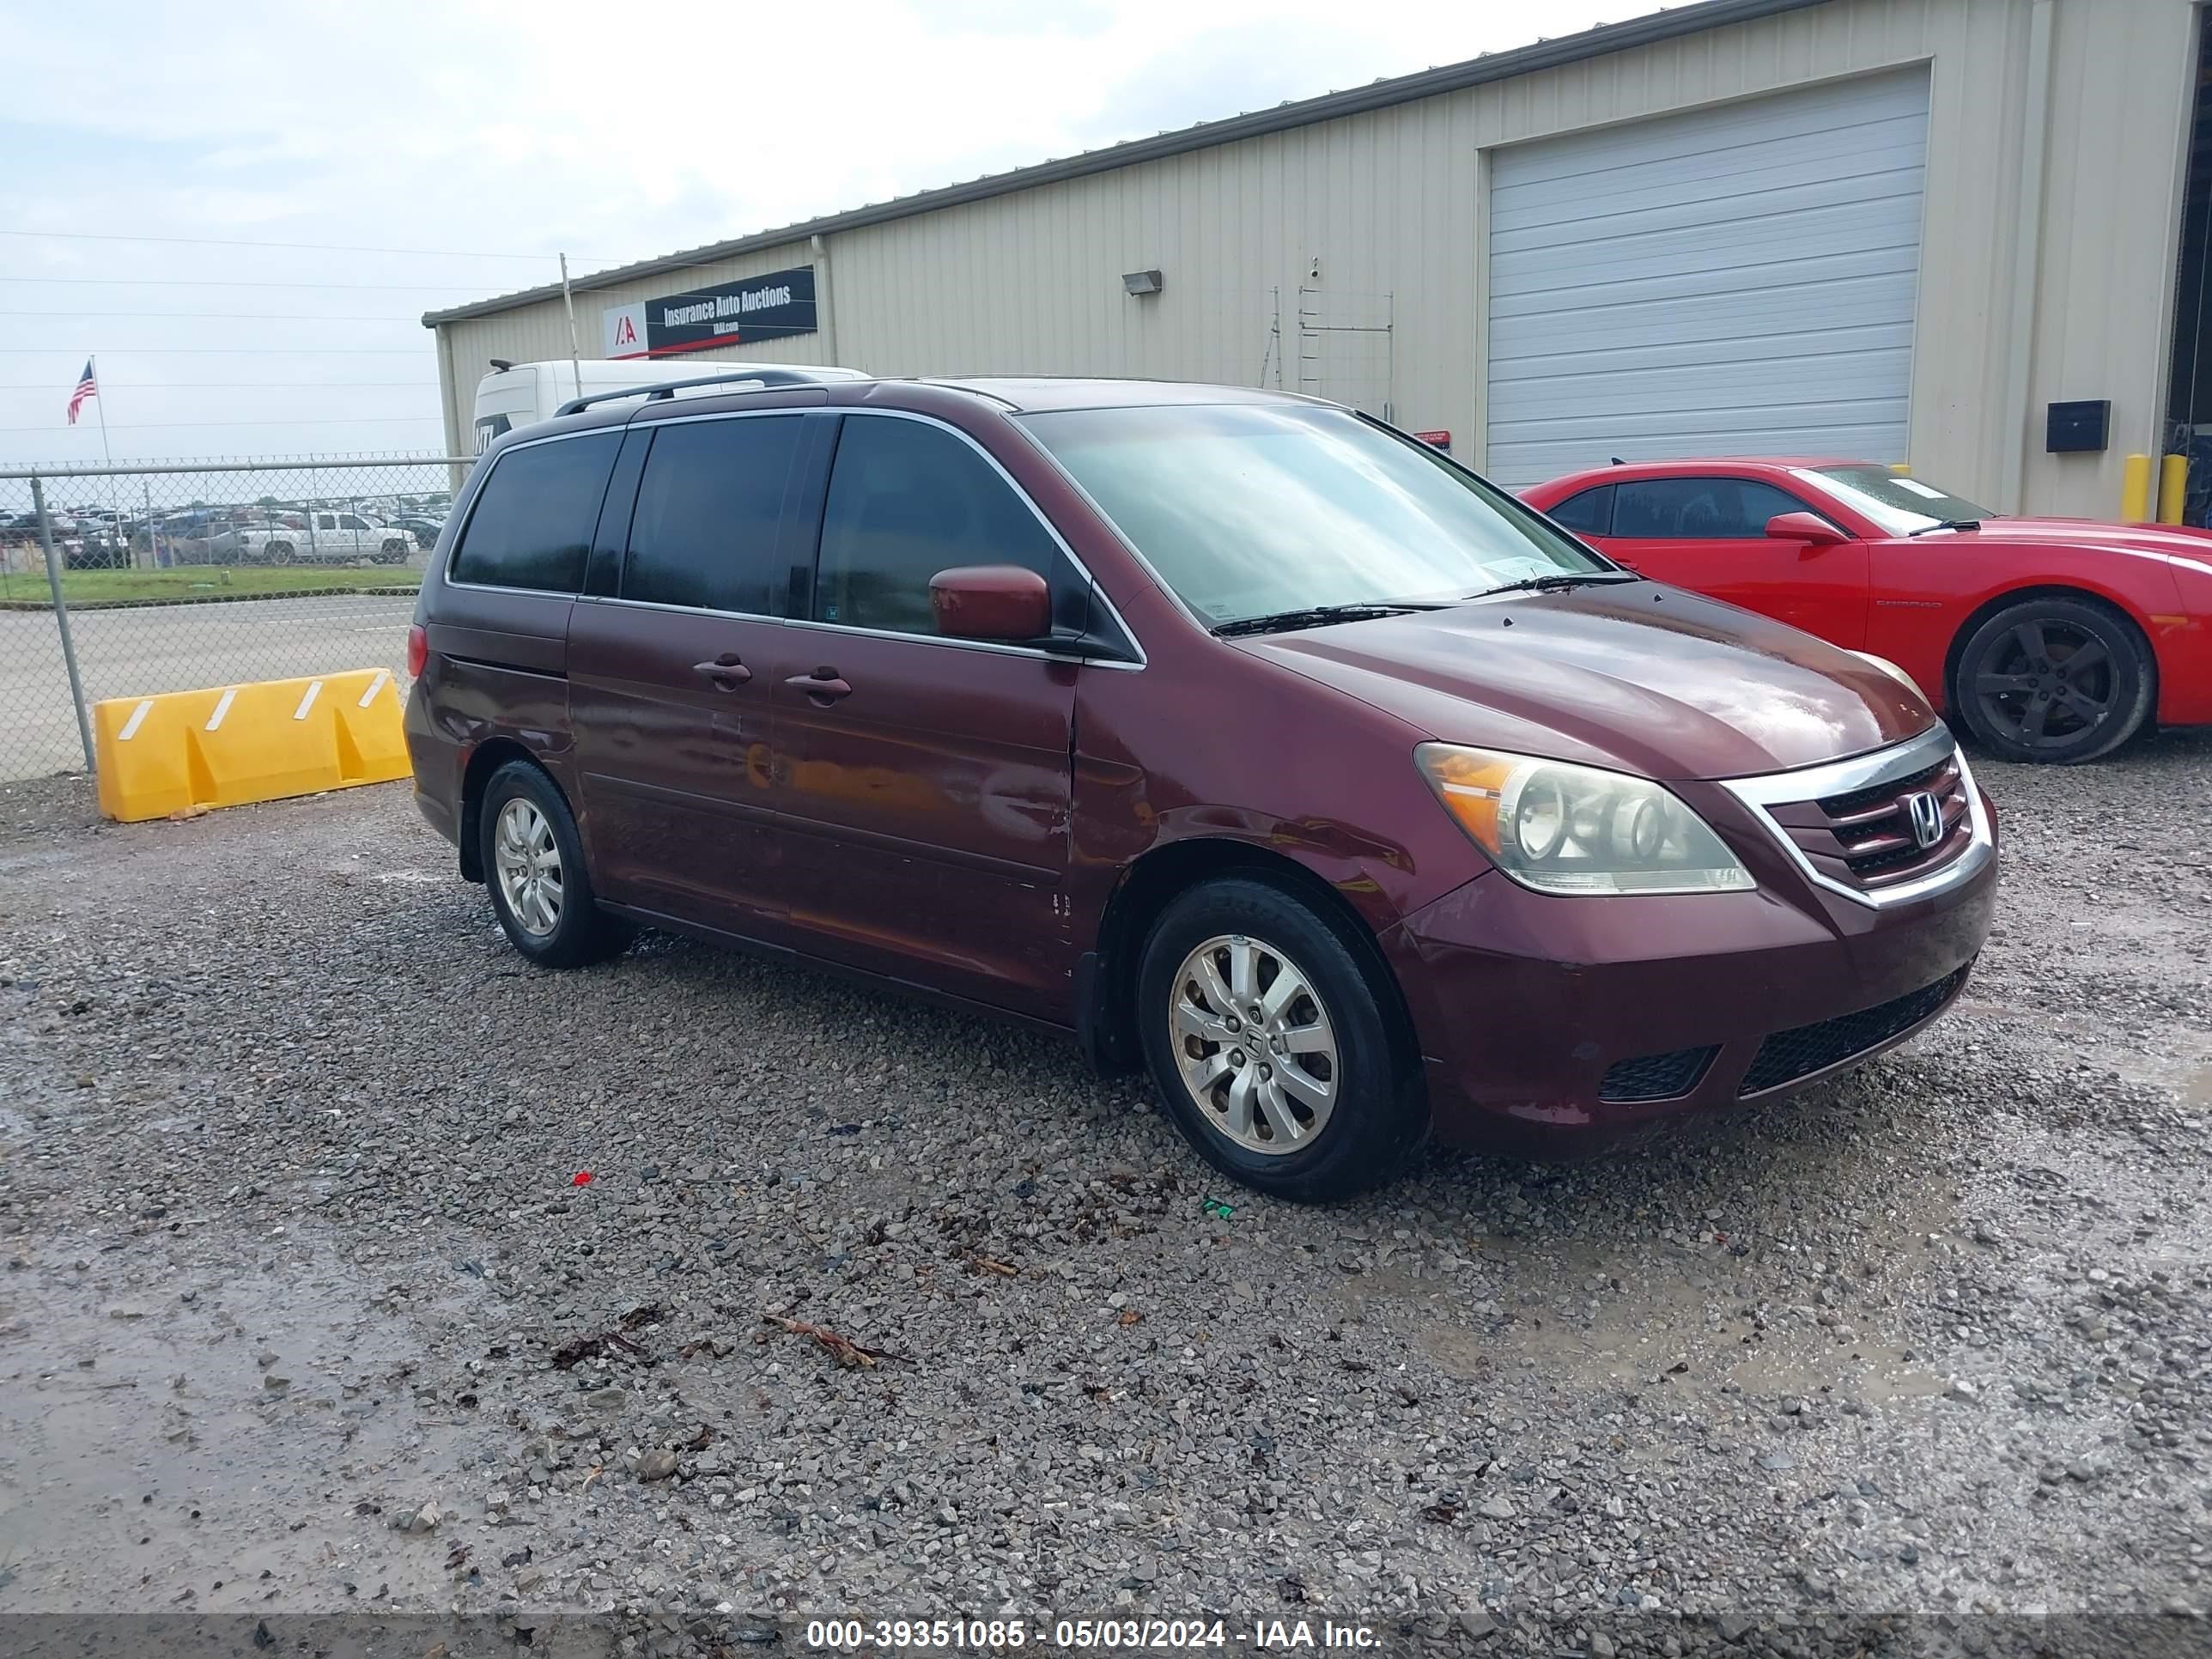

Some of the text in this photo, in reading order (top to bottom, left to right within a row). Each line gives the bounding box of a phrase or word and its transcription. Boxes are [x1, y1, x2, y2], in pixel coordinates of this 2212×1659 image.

[664, 285, 791, 327] Insurance Auto Auctions
